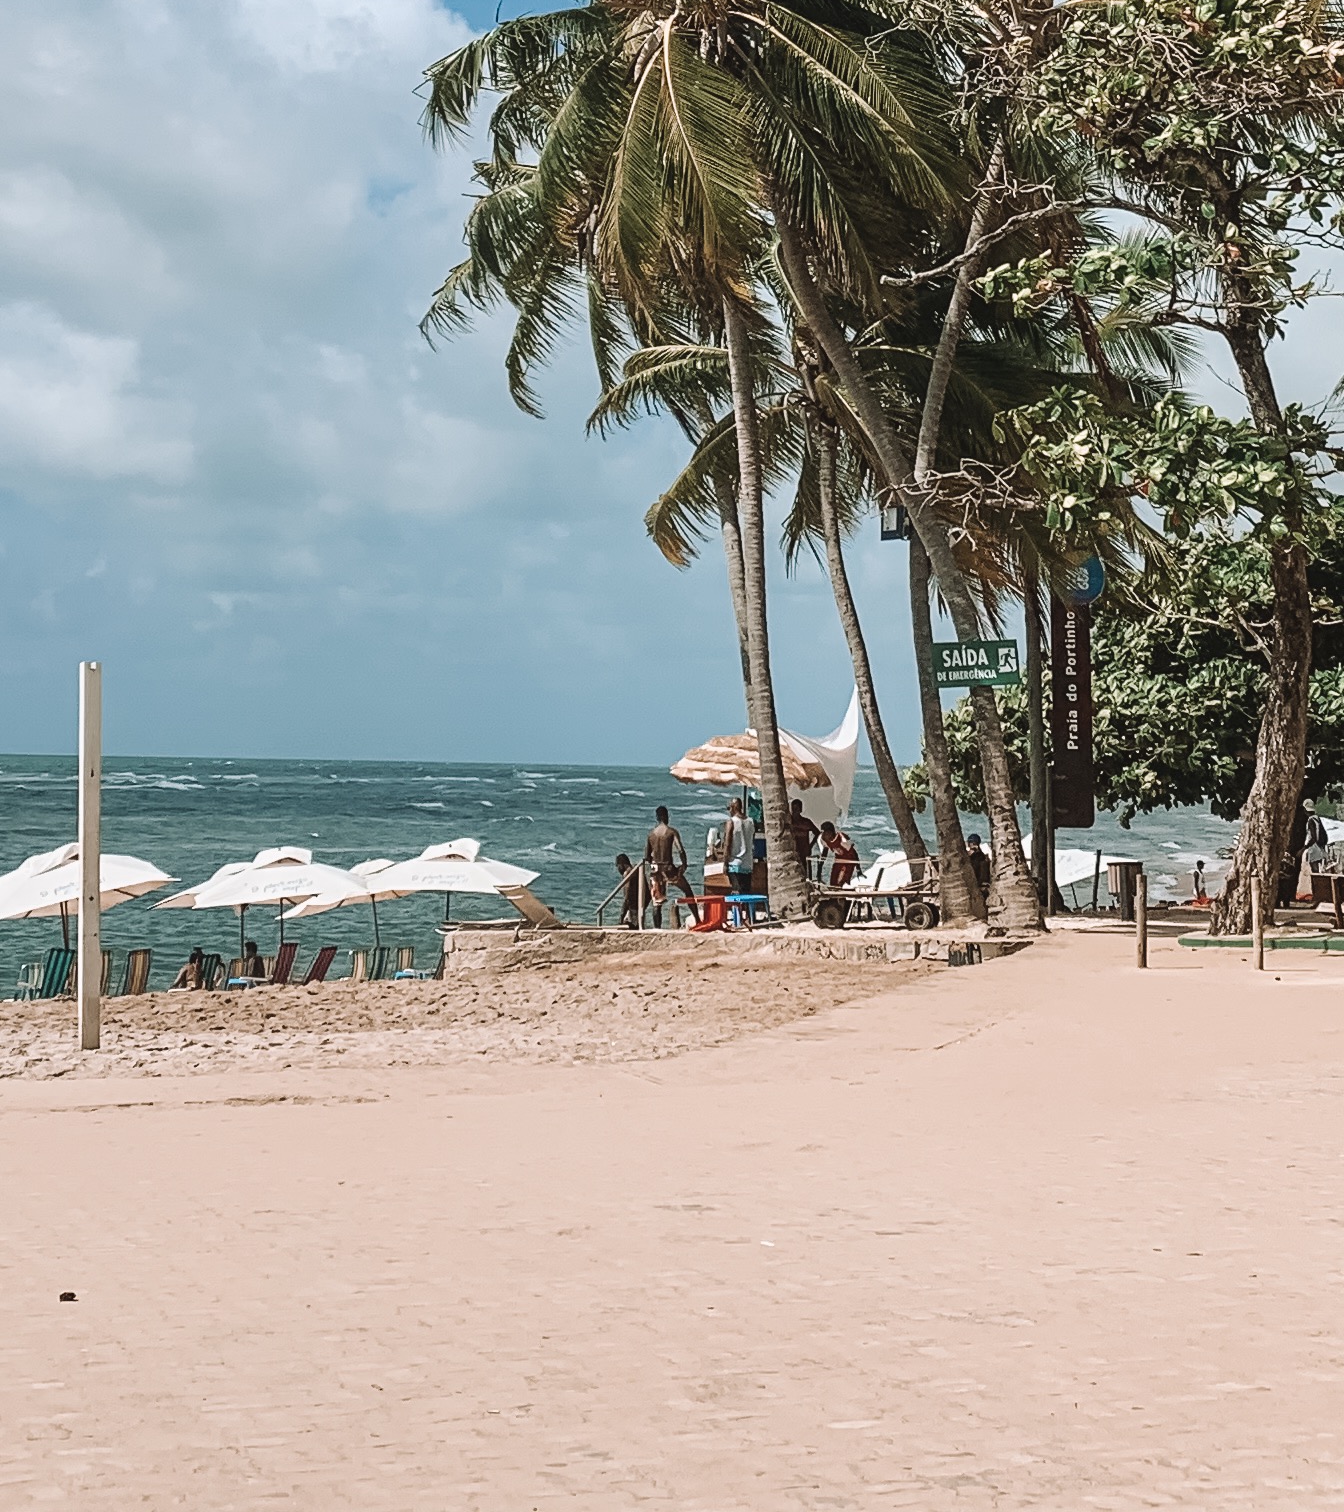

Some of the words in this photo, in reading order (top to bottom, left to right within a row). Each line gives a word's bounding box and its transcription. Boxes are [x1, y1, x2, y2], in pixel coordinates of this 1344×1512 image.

[1064, 611, 1077, 676] Portinho
[942, 644, 989, 668] SAÍDA
[937, 671, 947, 682] DE
[948, 668, 997, 681] EMERGÊNCIA
[1065, 684, 1077, 702] do
[1066, 709, 1079, 750] Praia
